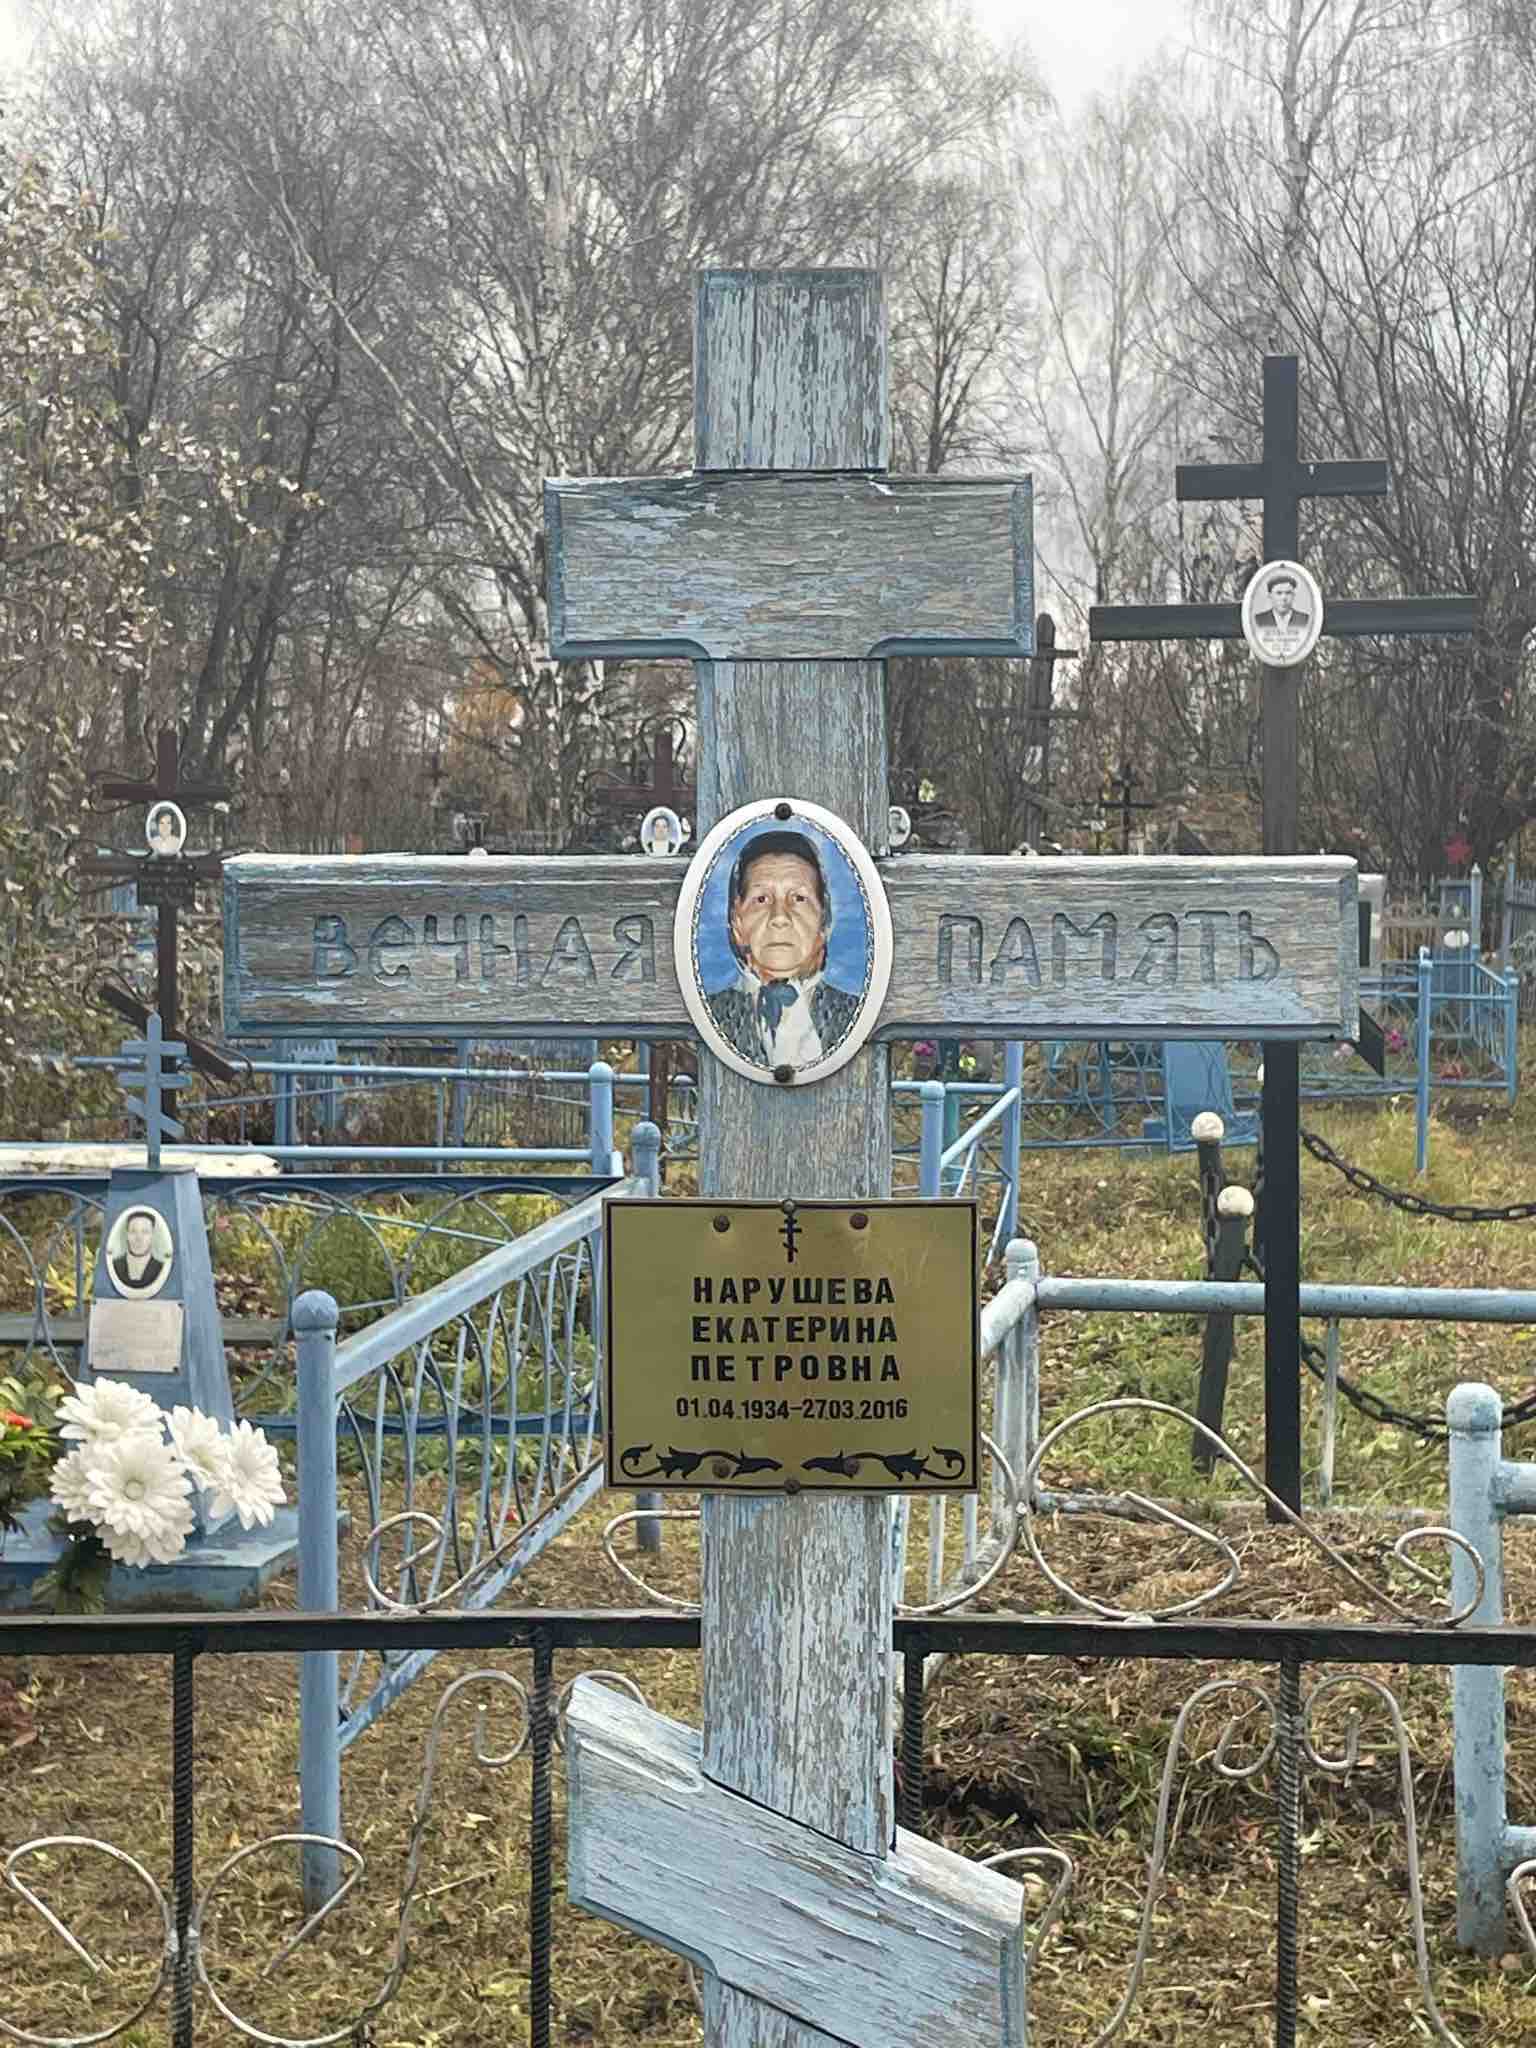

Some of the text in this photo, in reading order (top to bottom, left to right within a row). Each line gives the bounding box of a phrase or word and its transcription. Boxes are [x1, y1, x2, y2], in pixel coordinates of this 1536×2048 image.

[937, 910, 1281, 989] ПАМЯТЬ
[693, 1276, 895, 1304] НАРУШЕВА
[692, 1316, 897, 1343] ЕКАТЕРИНА
[691, 1354, 900, 1382] ПЕТРОВНА
